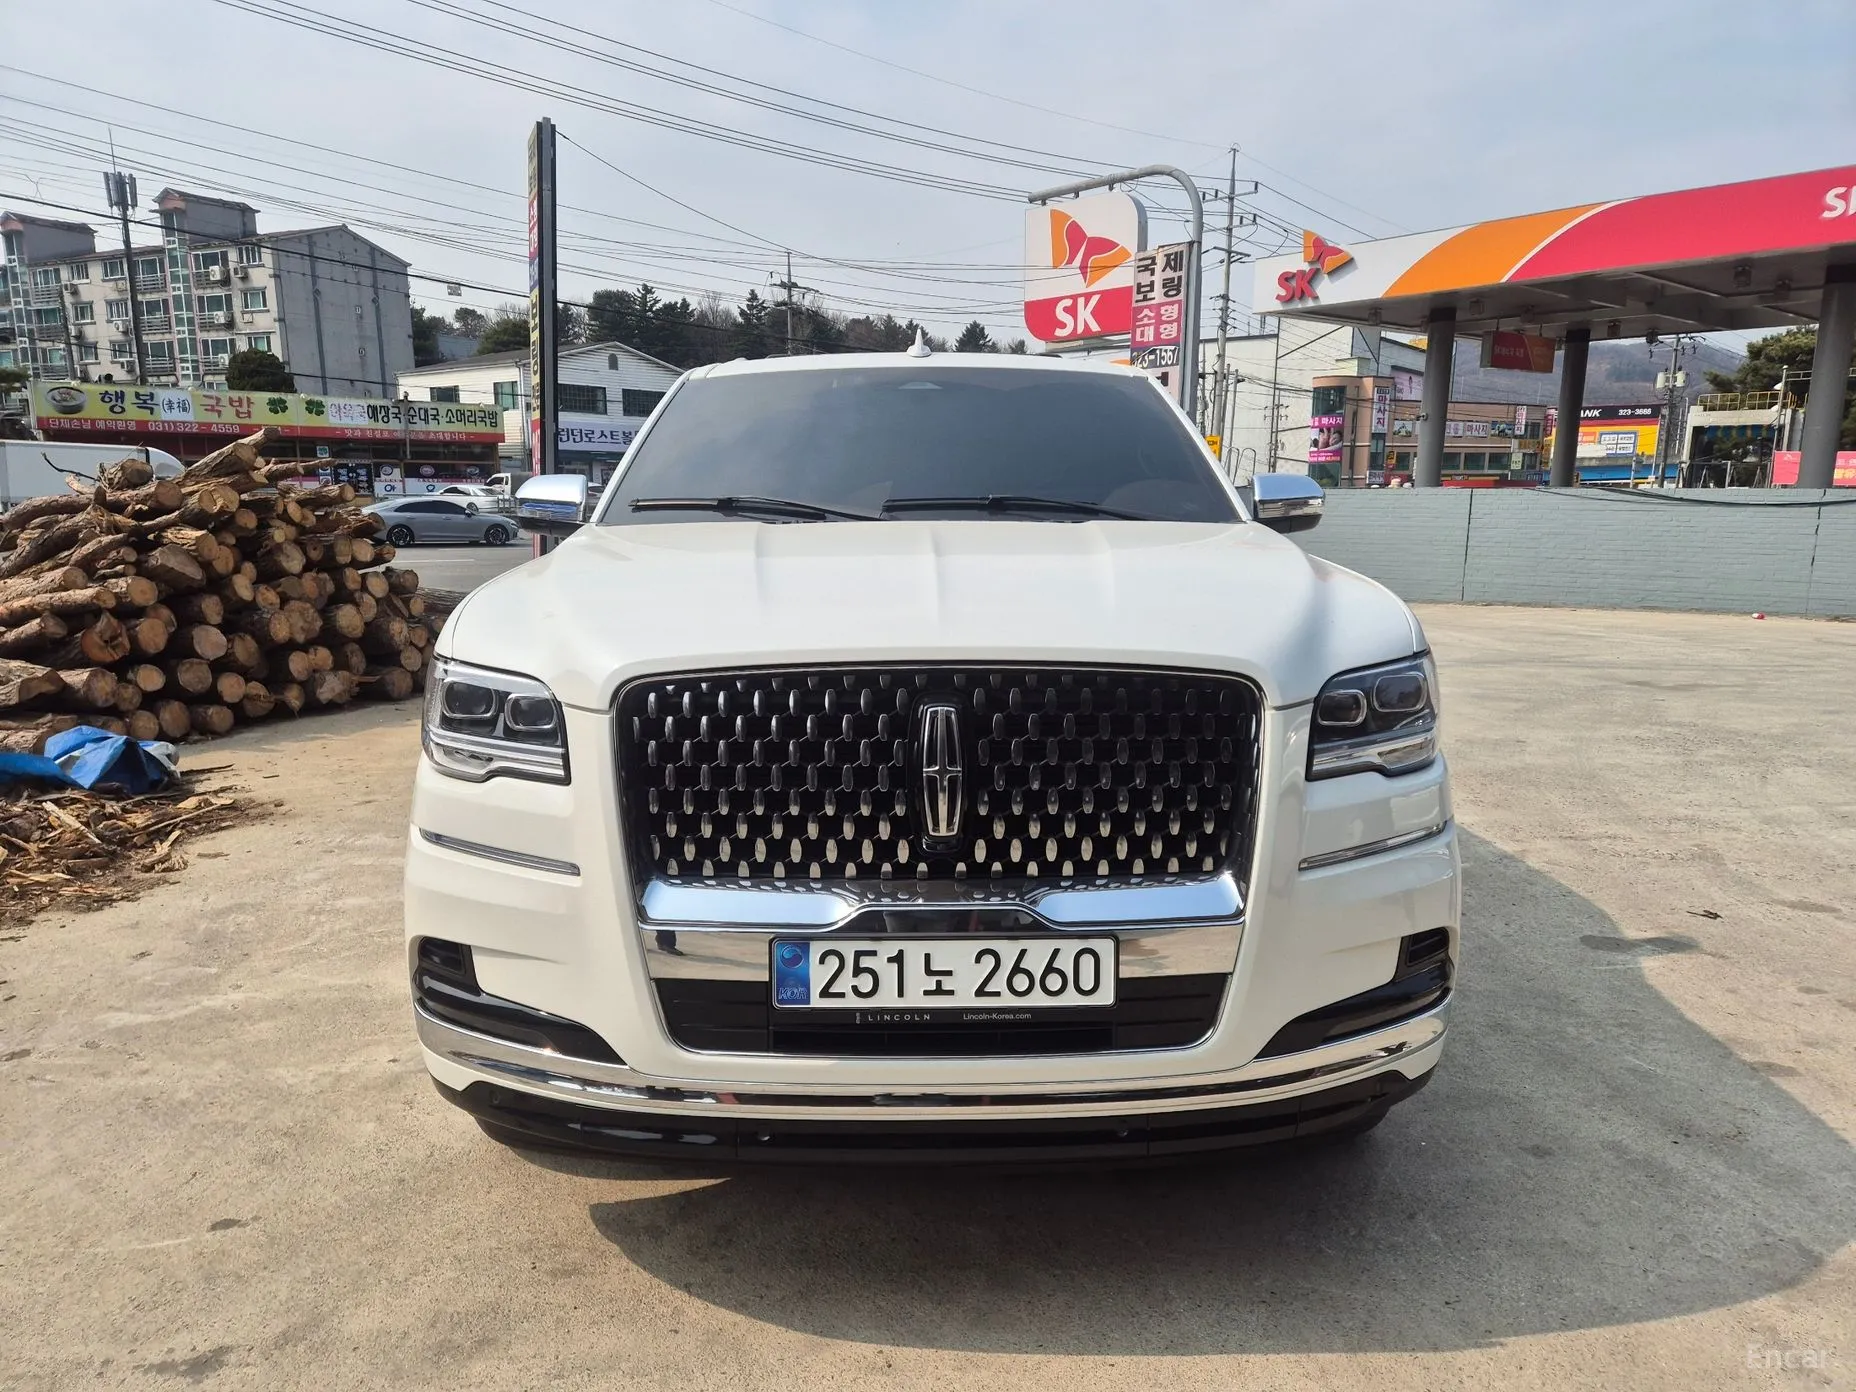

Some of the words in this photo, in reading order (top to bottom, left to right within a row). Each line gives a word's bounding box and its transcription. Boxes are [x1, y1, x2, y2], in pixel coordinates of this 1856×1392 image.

[1136, 250, 1184, 277] 국제
[1135, 276, 1183, 303] 보링
[1276, 269, 1320, 303] SK
[1054, 294, 1102, 337] SK
[1135, 303, 1179, 326] 소형
[1135, 322, 1178, 342] 대형
[200, 393, 254, 419] 국밥
[1376, 395, 1388, 428] 마사지
[49, 419, 92, 430] 단체손님
[96, 420, 137, 431] 예약환영
[1321, 416, 1343, 425] 마사지
[973, 947, 1102, 998] 2660
[868, 1013, 931, 1021] LINCOLN
[963, 1012, 1032, 1021] Lincoln-Korea.com
